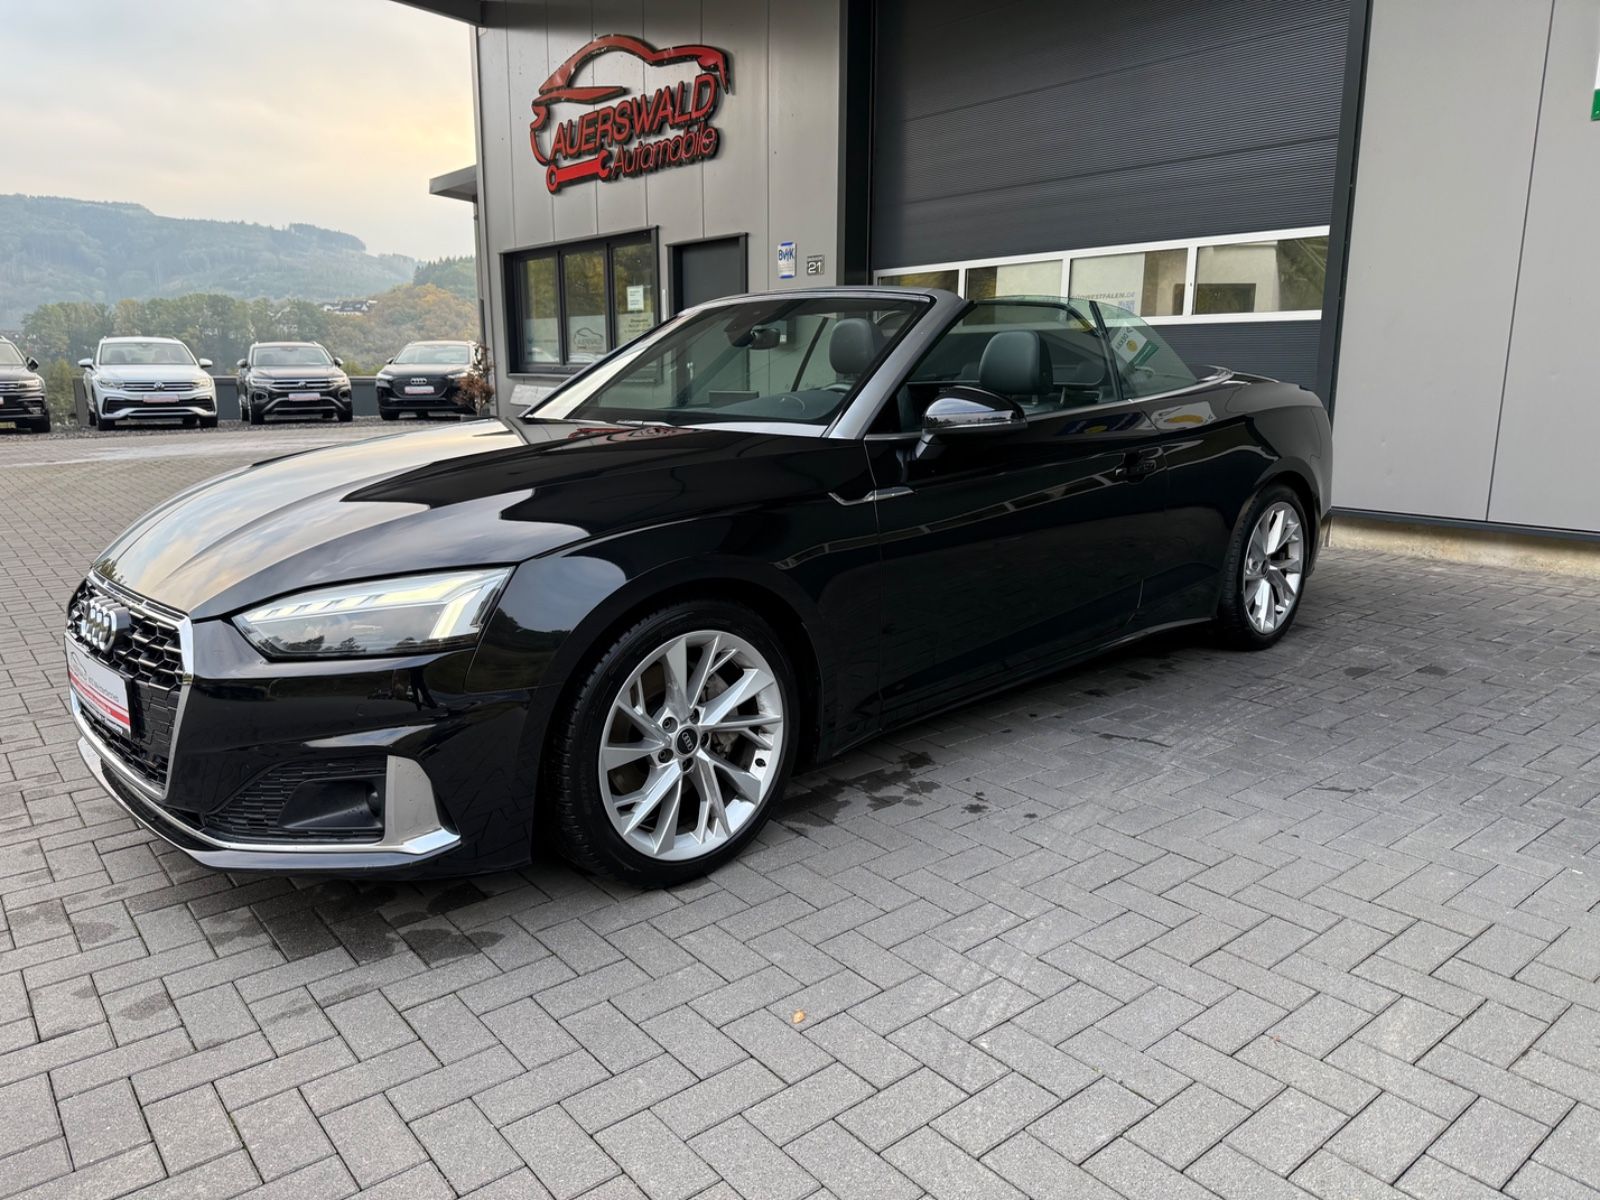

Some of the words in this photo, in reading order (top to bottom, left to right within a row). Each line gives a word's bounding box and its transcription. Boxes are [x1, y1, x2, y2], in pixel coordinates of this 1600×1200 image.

[550, 73, 718, 160] AUERSWALD
[612, 122, 718, 176] Automobile
[808, 261, 821, 274] 21
